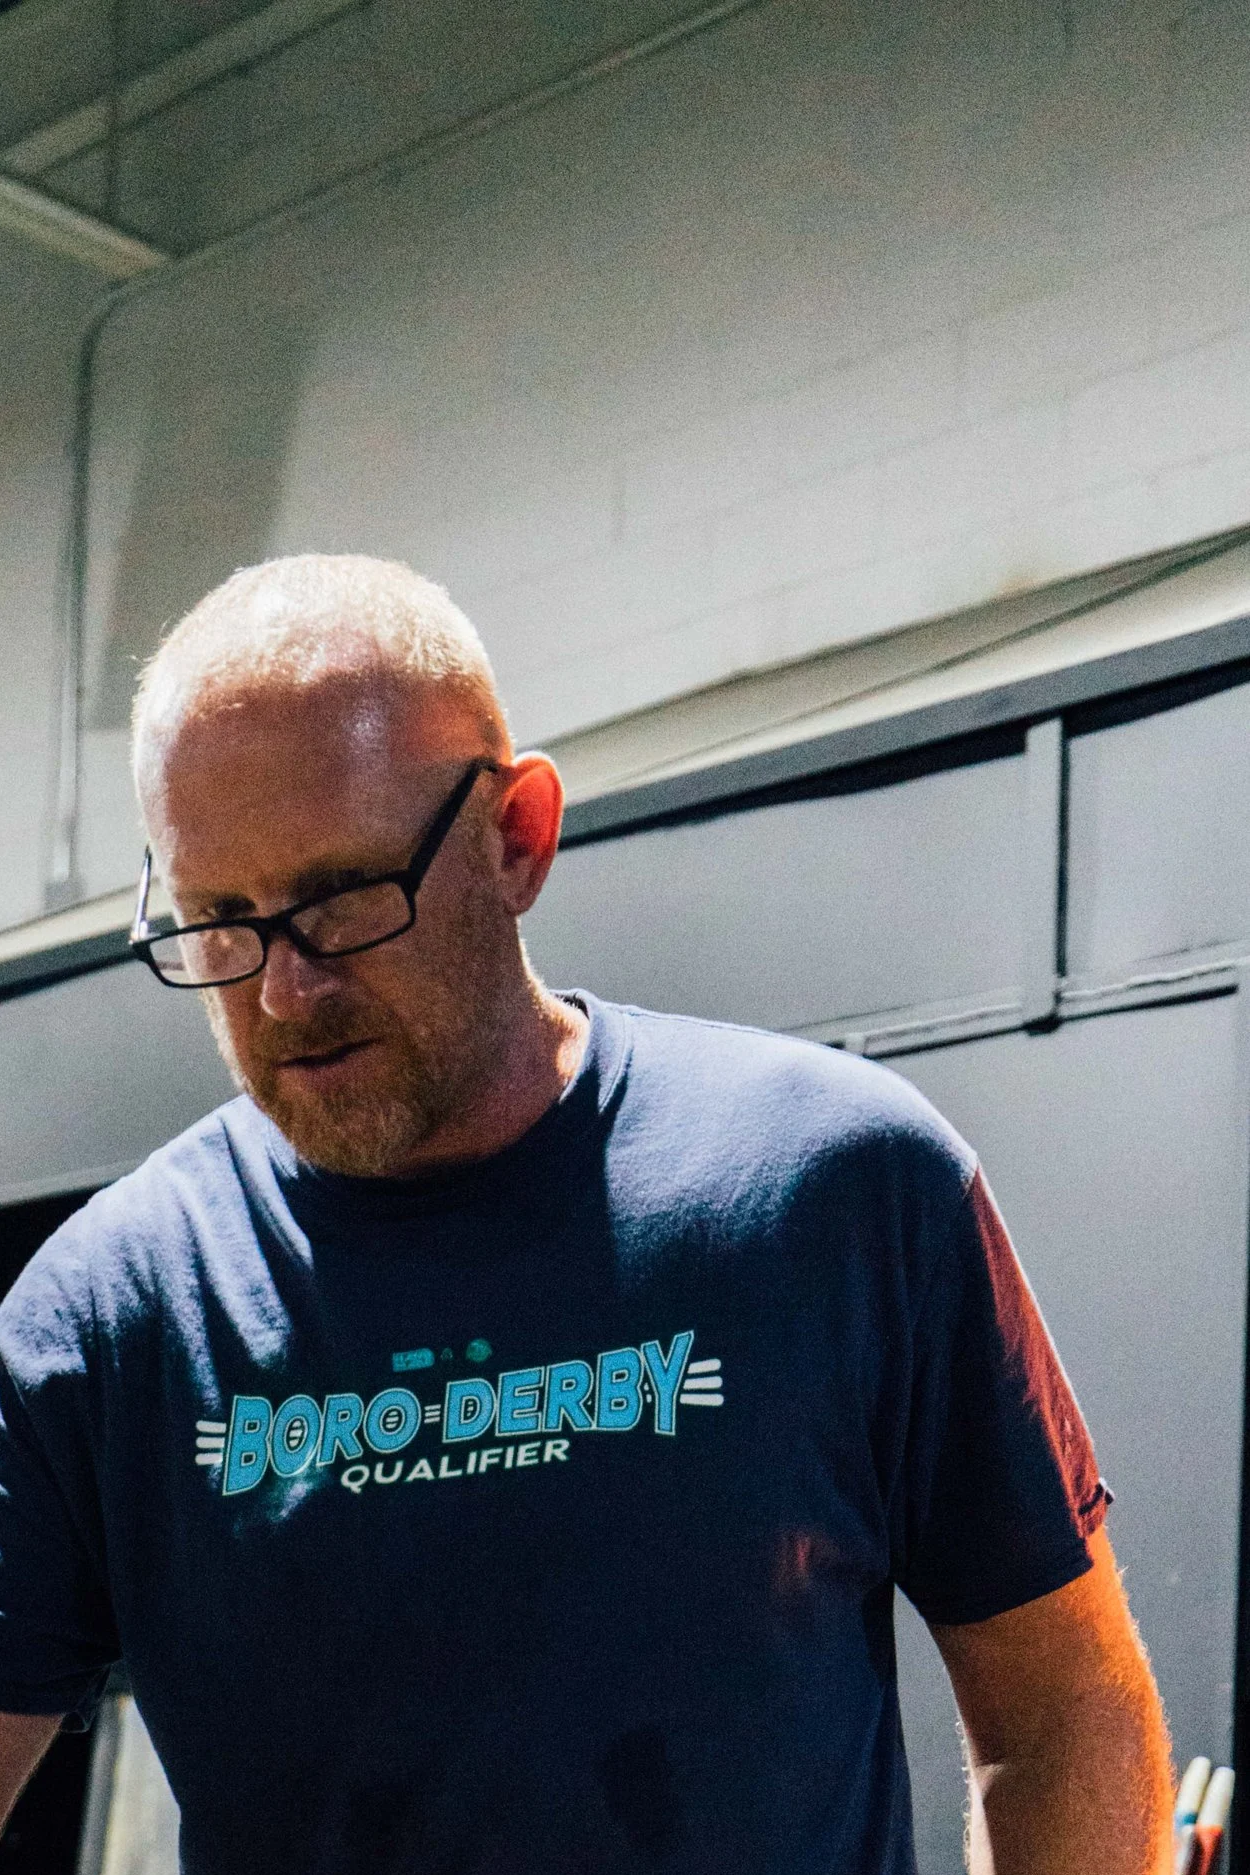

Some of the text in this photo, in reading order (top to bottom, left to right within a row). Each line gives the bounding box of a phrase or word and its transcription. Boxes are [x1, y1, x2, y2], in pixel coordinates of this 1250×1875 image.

[222, 1330, 694, 1496] BORO DERBY
[340, 1439, 571, 1494] QUALIFIER
